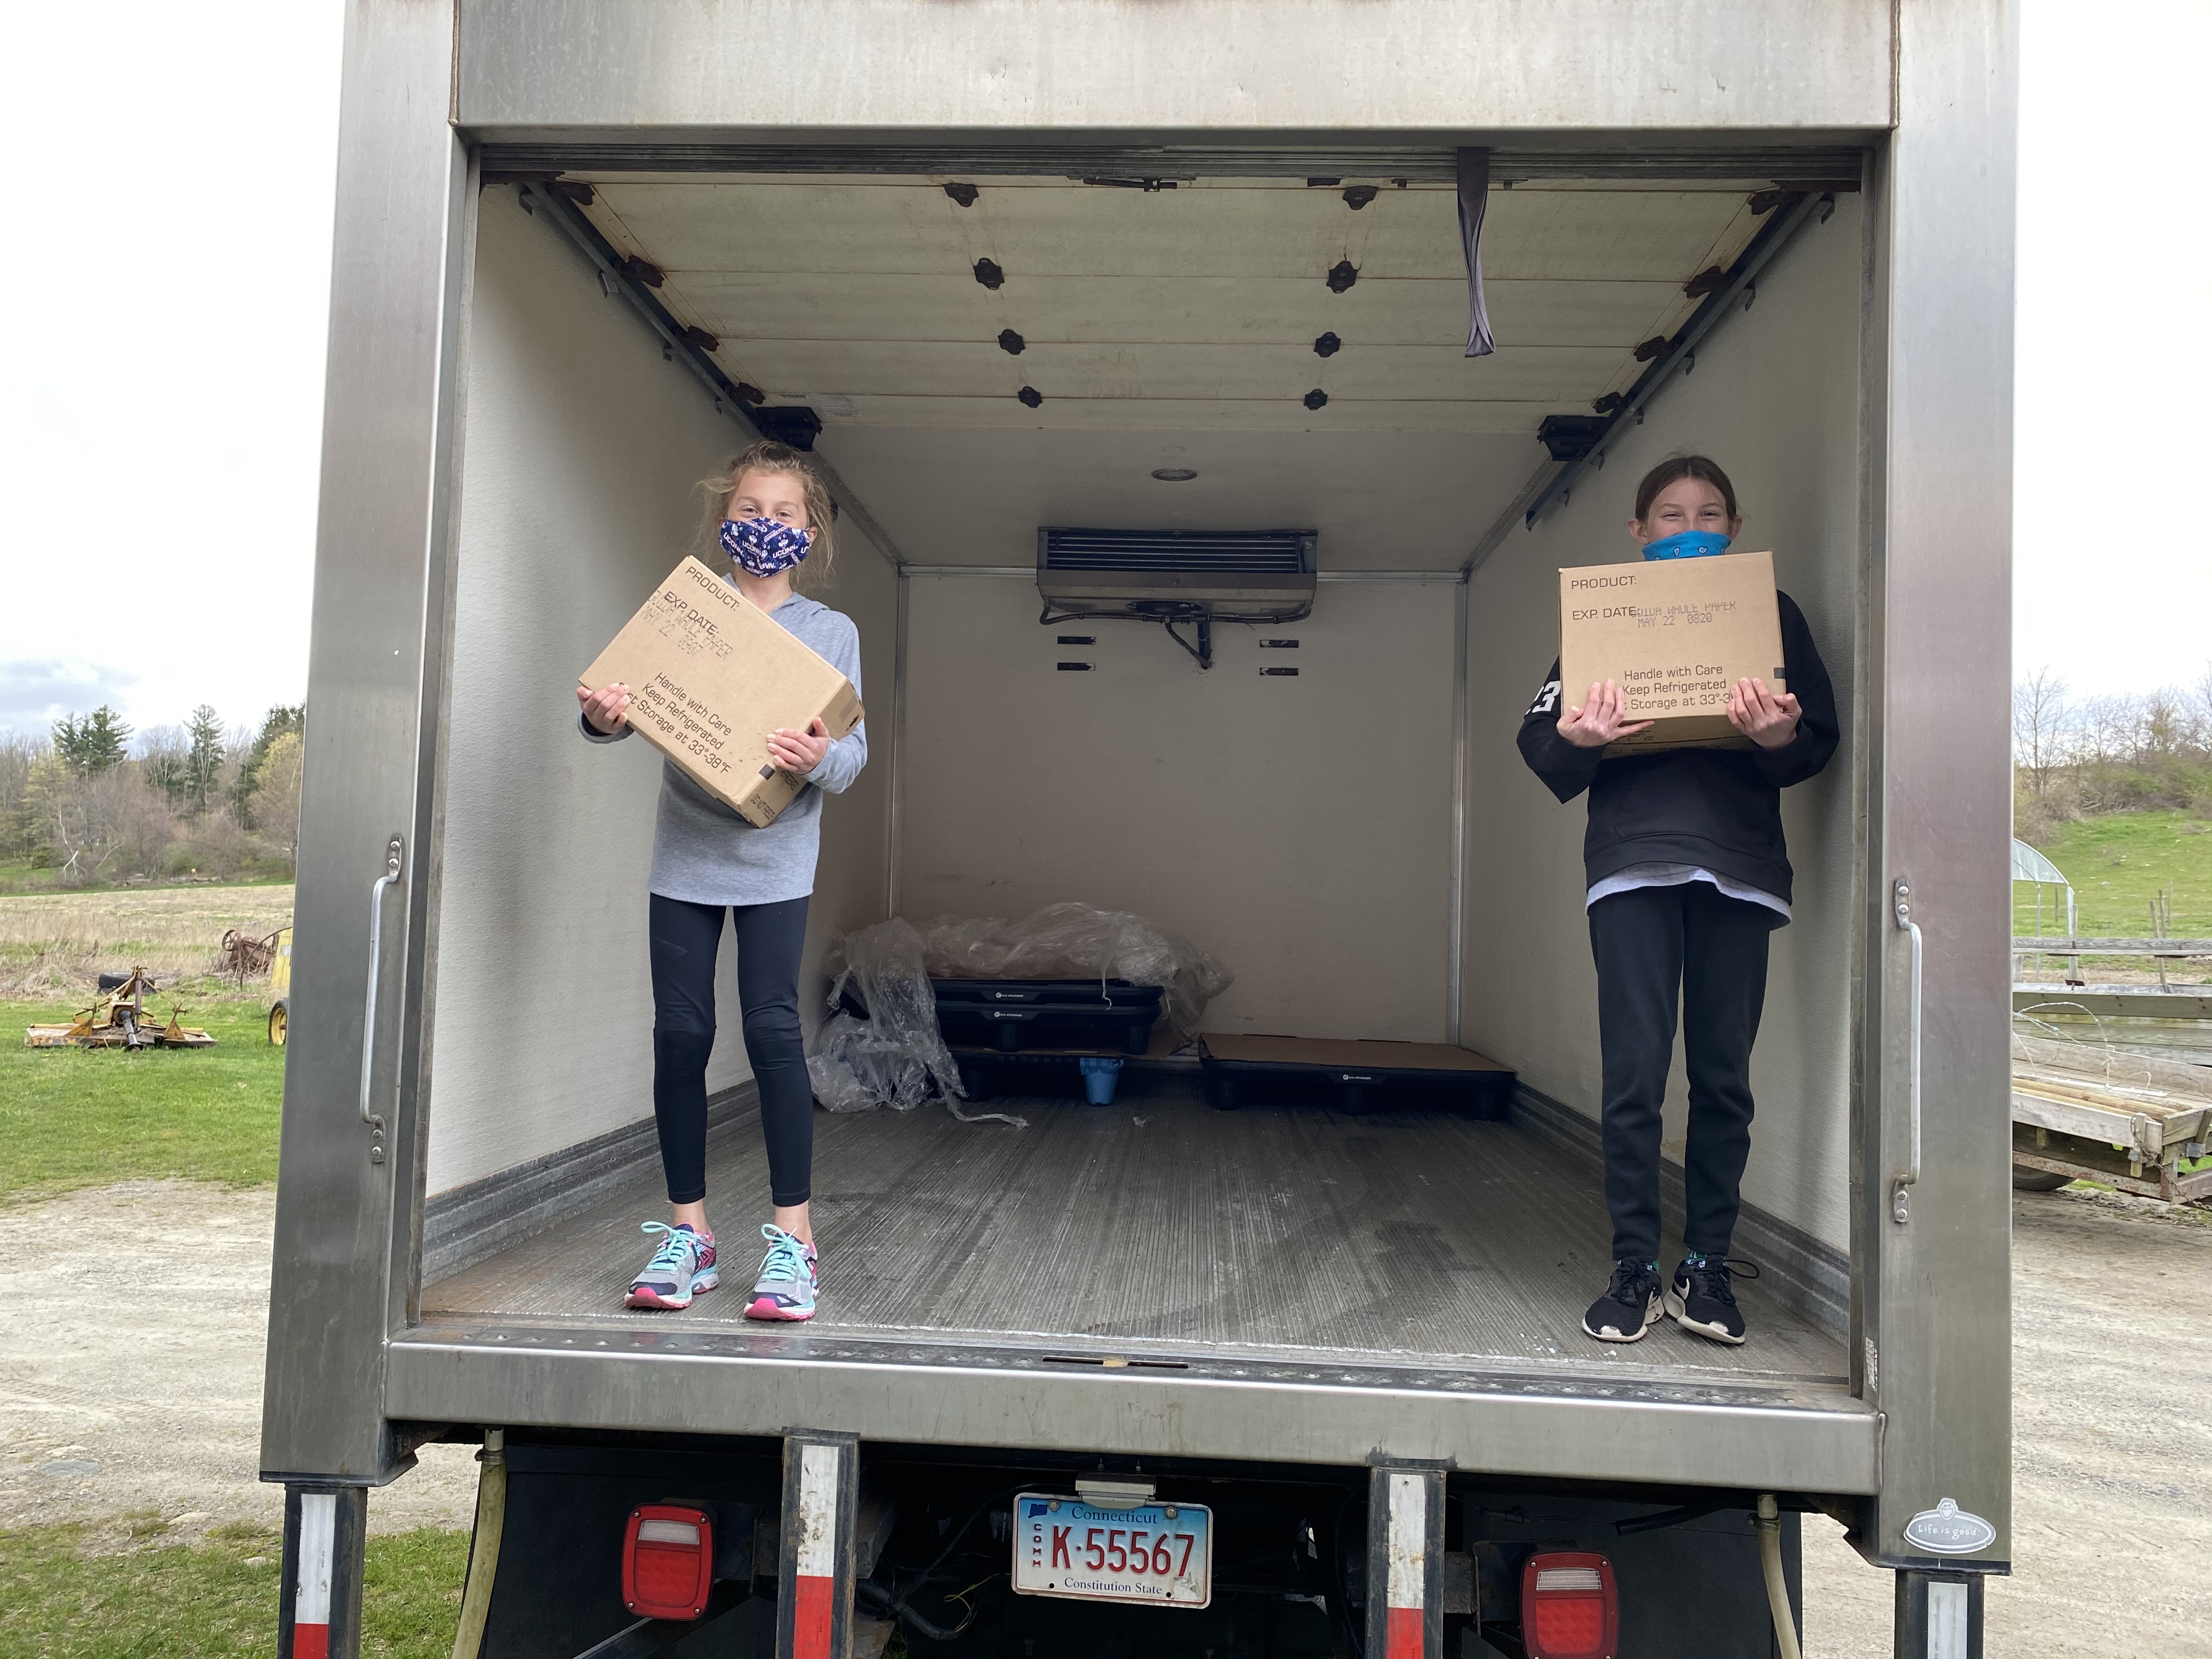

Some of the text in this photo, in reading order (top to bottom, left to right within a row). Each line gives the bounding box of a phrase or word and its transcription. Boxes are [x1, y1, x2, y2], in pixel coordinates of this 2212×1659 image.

[772, 544, 796, 558] UCONN
[685, 566, 740, 612] PRODUCT:
[1571, 575, 1637, 590] PRODUCT:
[1572, 610, 1598, 620] EXP.
[1638, 612, 1713, 628] MAY 22 0820
[1624, 664, 1723, 680] Handle with Care
[1622, 679, 1726, 697] Keep Refrigerated
[654, 672, 732, 736] Handle with Care
[1630, 698, 1677, 710] Storage
[1682, 696, 1696, 706] at
[637, 699, 675, 733] Storage
[675, 731, 690, 744] at
[641, 682, 725, 751] Keep Refrigerated
[1071, 1506, 1158, 1524] Connecticut
[1918, 1523, 1938, 1534] Life
[1064, 1577, 1163, 1595] Constitution State
